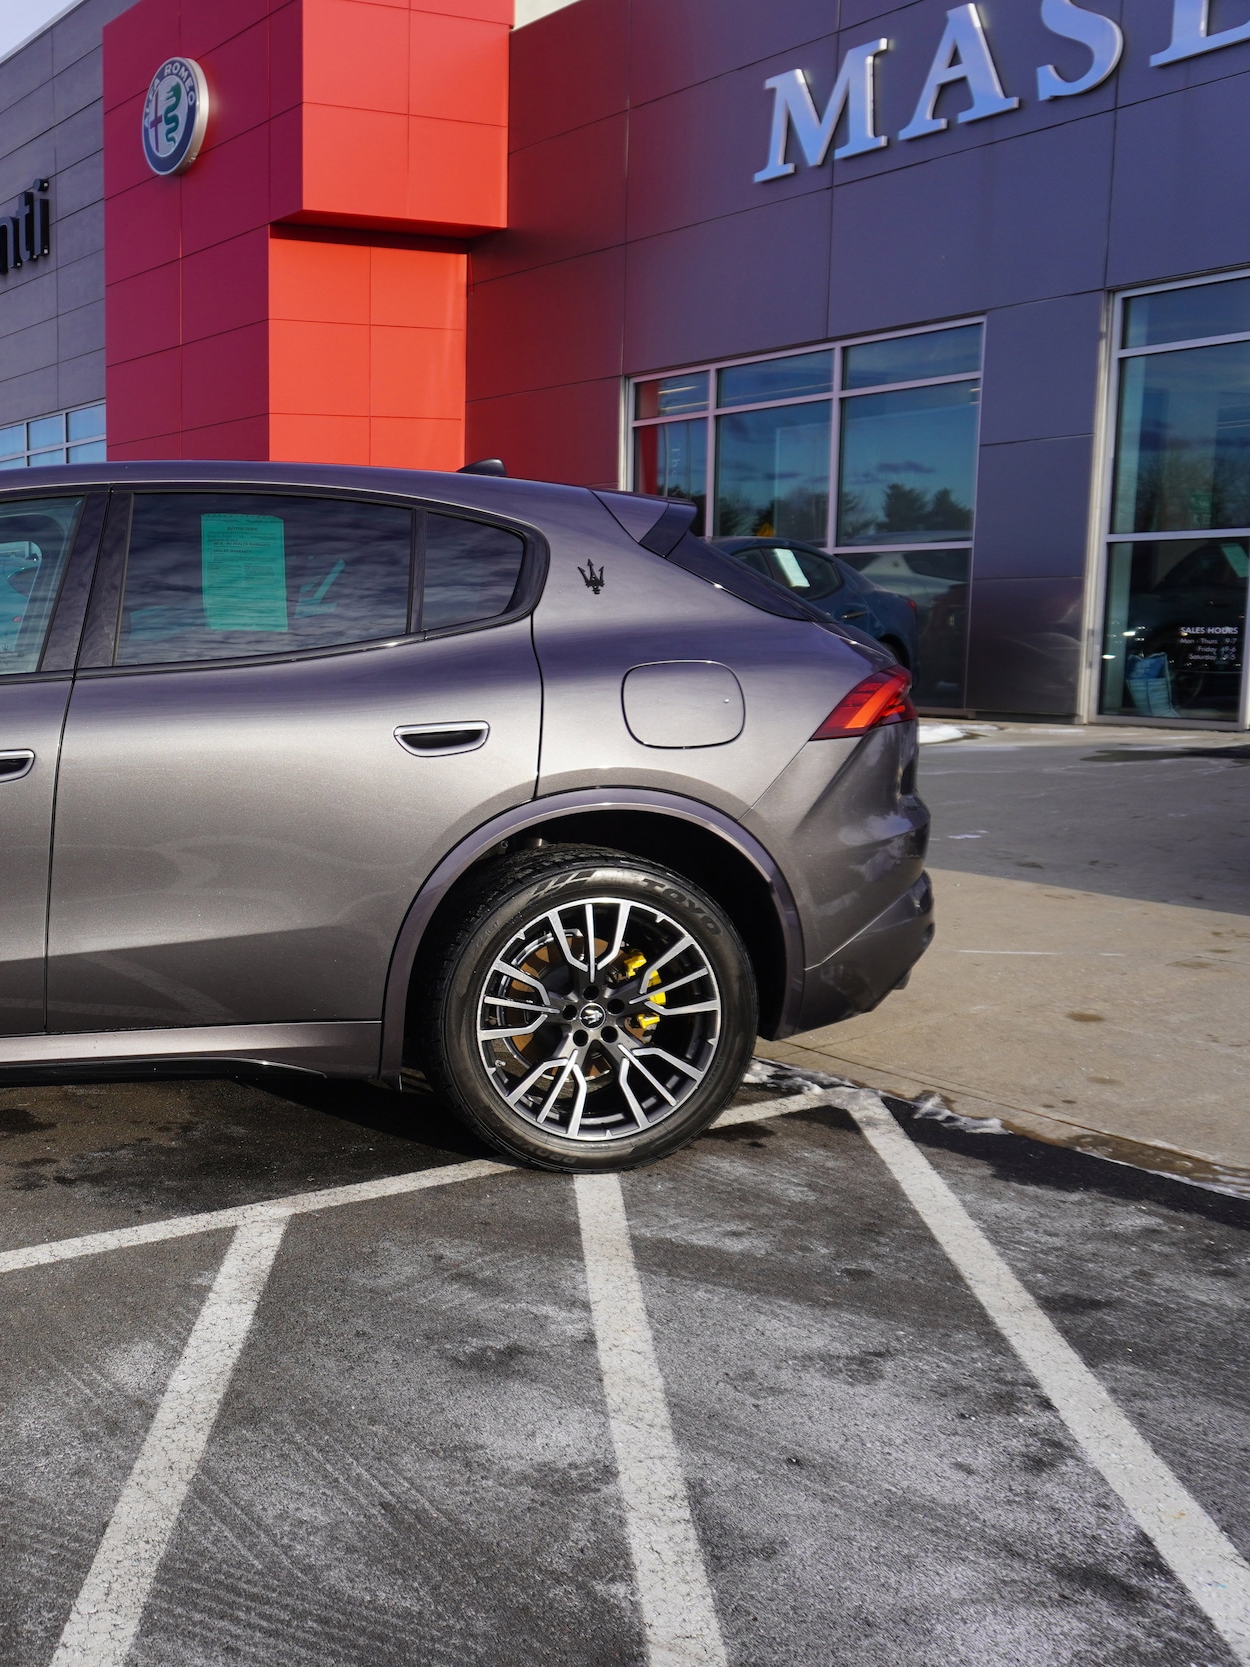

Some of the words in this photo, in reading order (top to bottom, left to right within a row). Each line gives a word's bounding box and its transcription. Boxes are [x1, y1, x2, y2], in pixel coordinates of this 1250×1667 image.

[144, 78, 161, 128] ALFA
[164, 62, 196, 106] ROMEO
[1180, 626, 1205, 635] SALES
[1207, 626, 1238, 635] HOURS
[1189, 653, 1217, 661] Saturday
[642, 878, 722, 936] TOYO
[501, 1128, 579, 1164] PROXES
